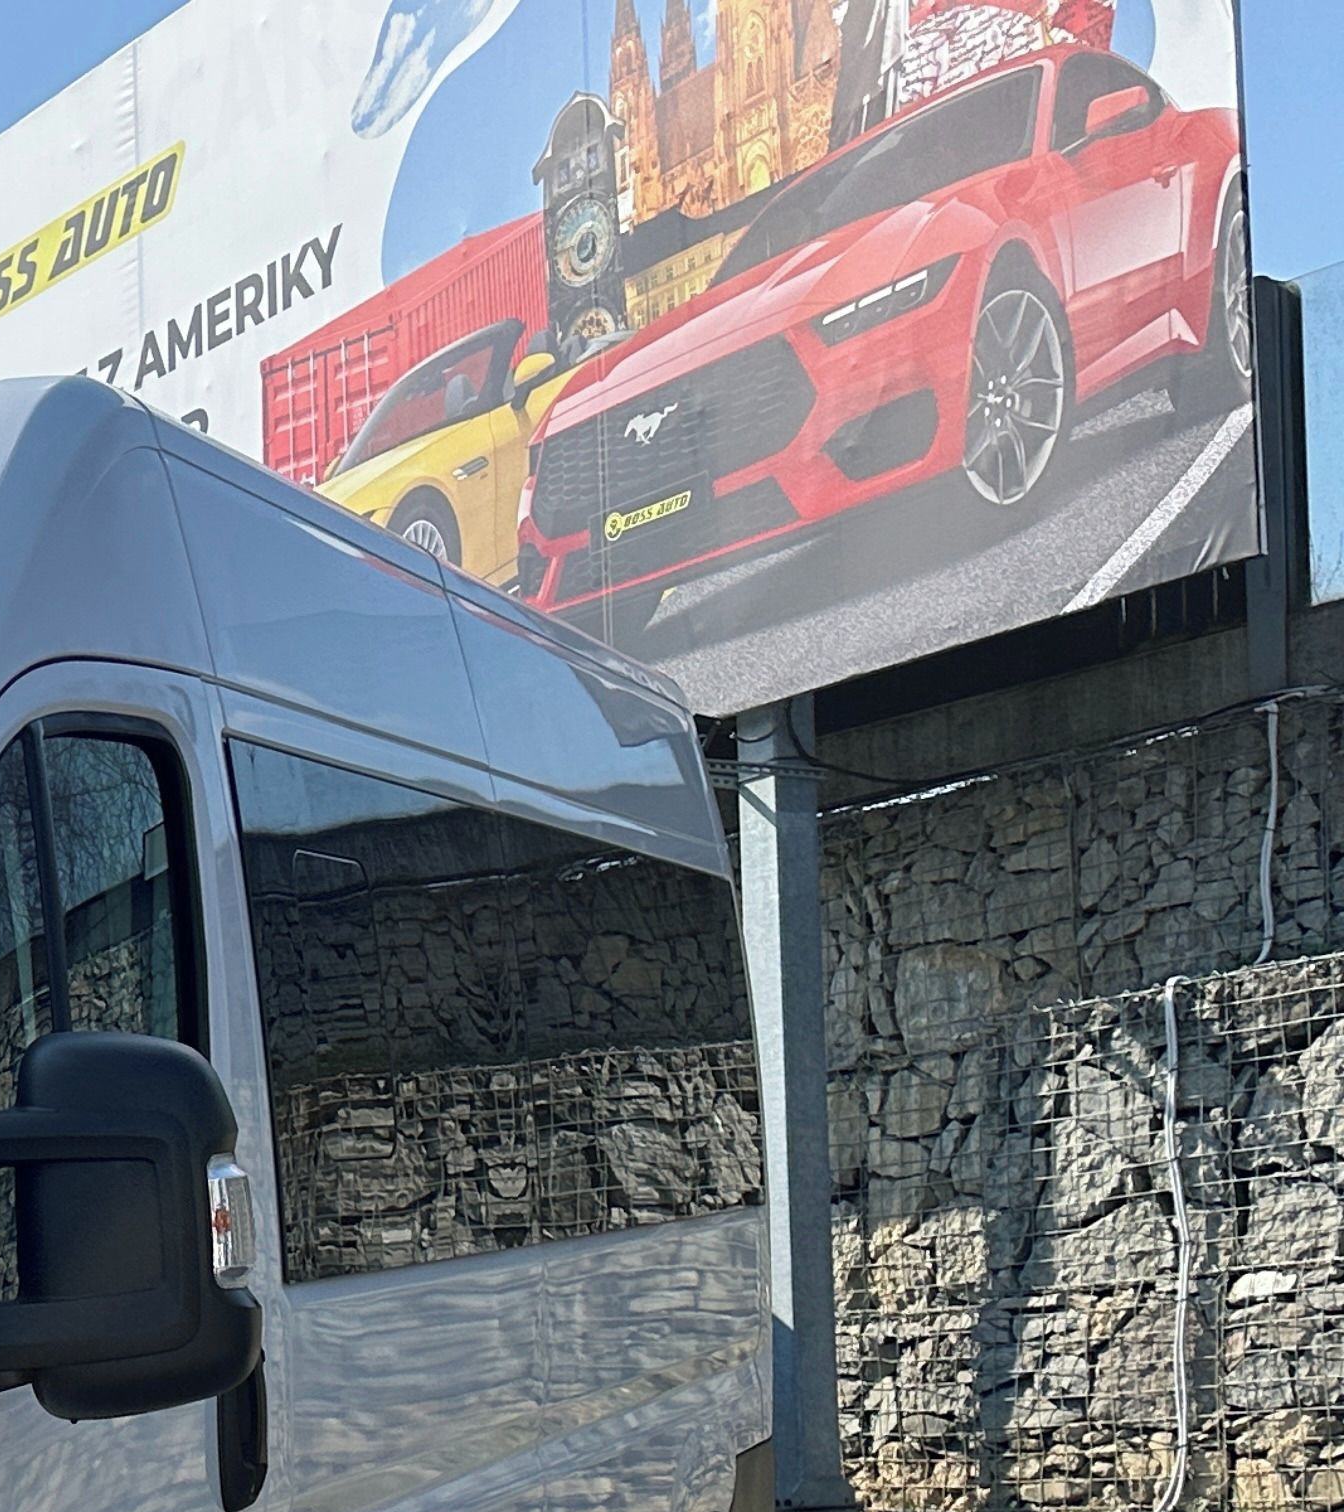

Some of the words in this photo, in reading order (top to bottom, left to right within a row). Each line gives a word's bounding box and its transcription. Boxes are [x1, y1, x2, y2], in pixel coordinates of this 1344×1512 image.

[48, 152, 179, 283] AUTO
[134, 223, 343, 391] AMERIKY
[624, 508, 653, 527] BOSS
[657, 494, 689, 516] AUTO
